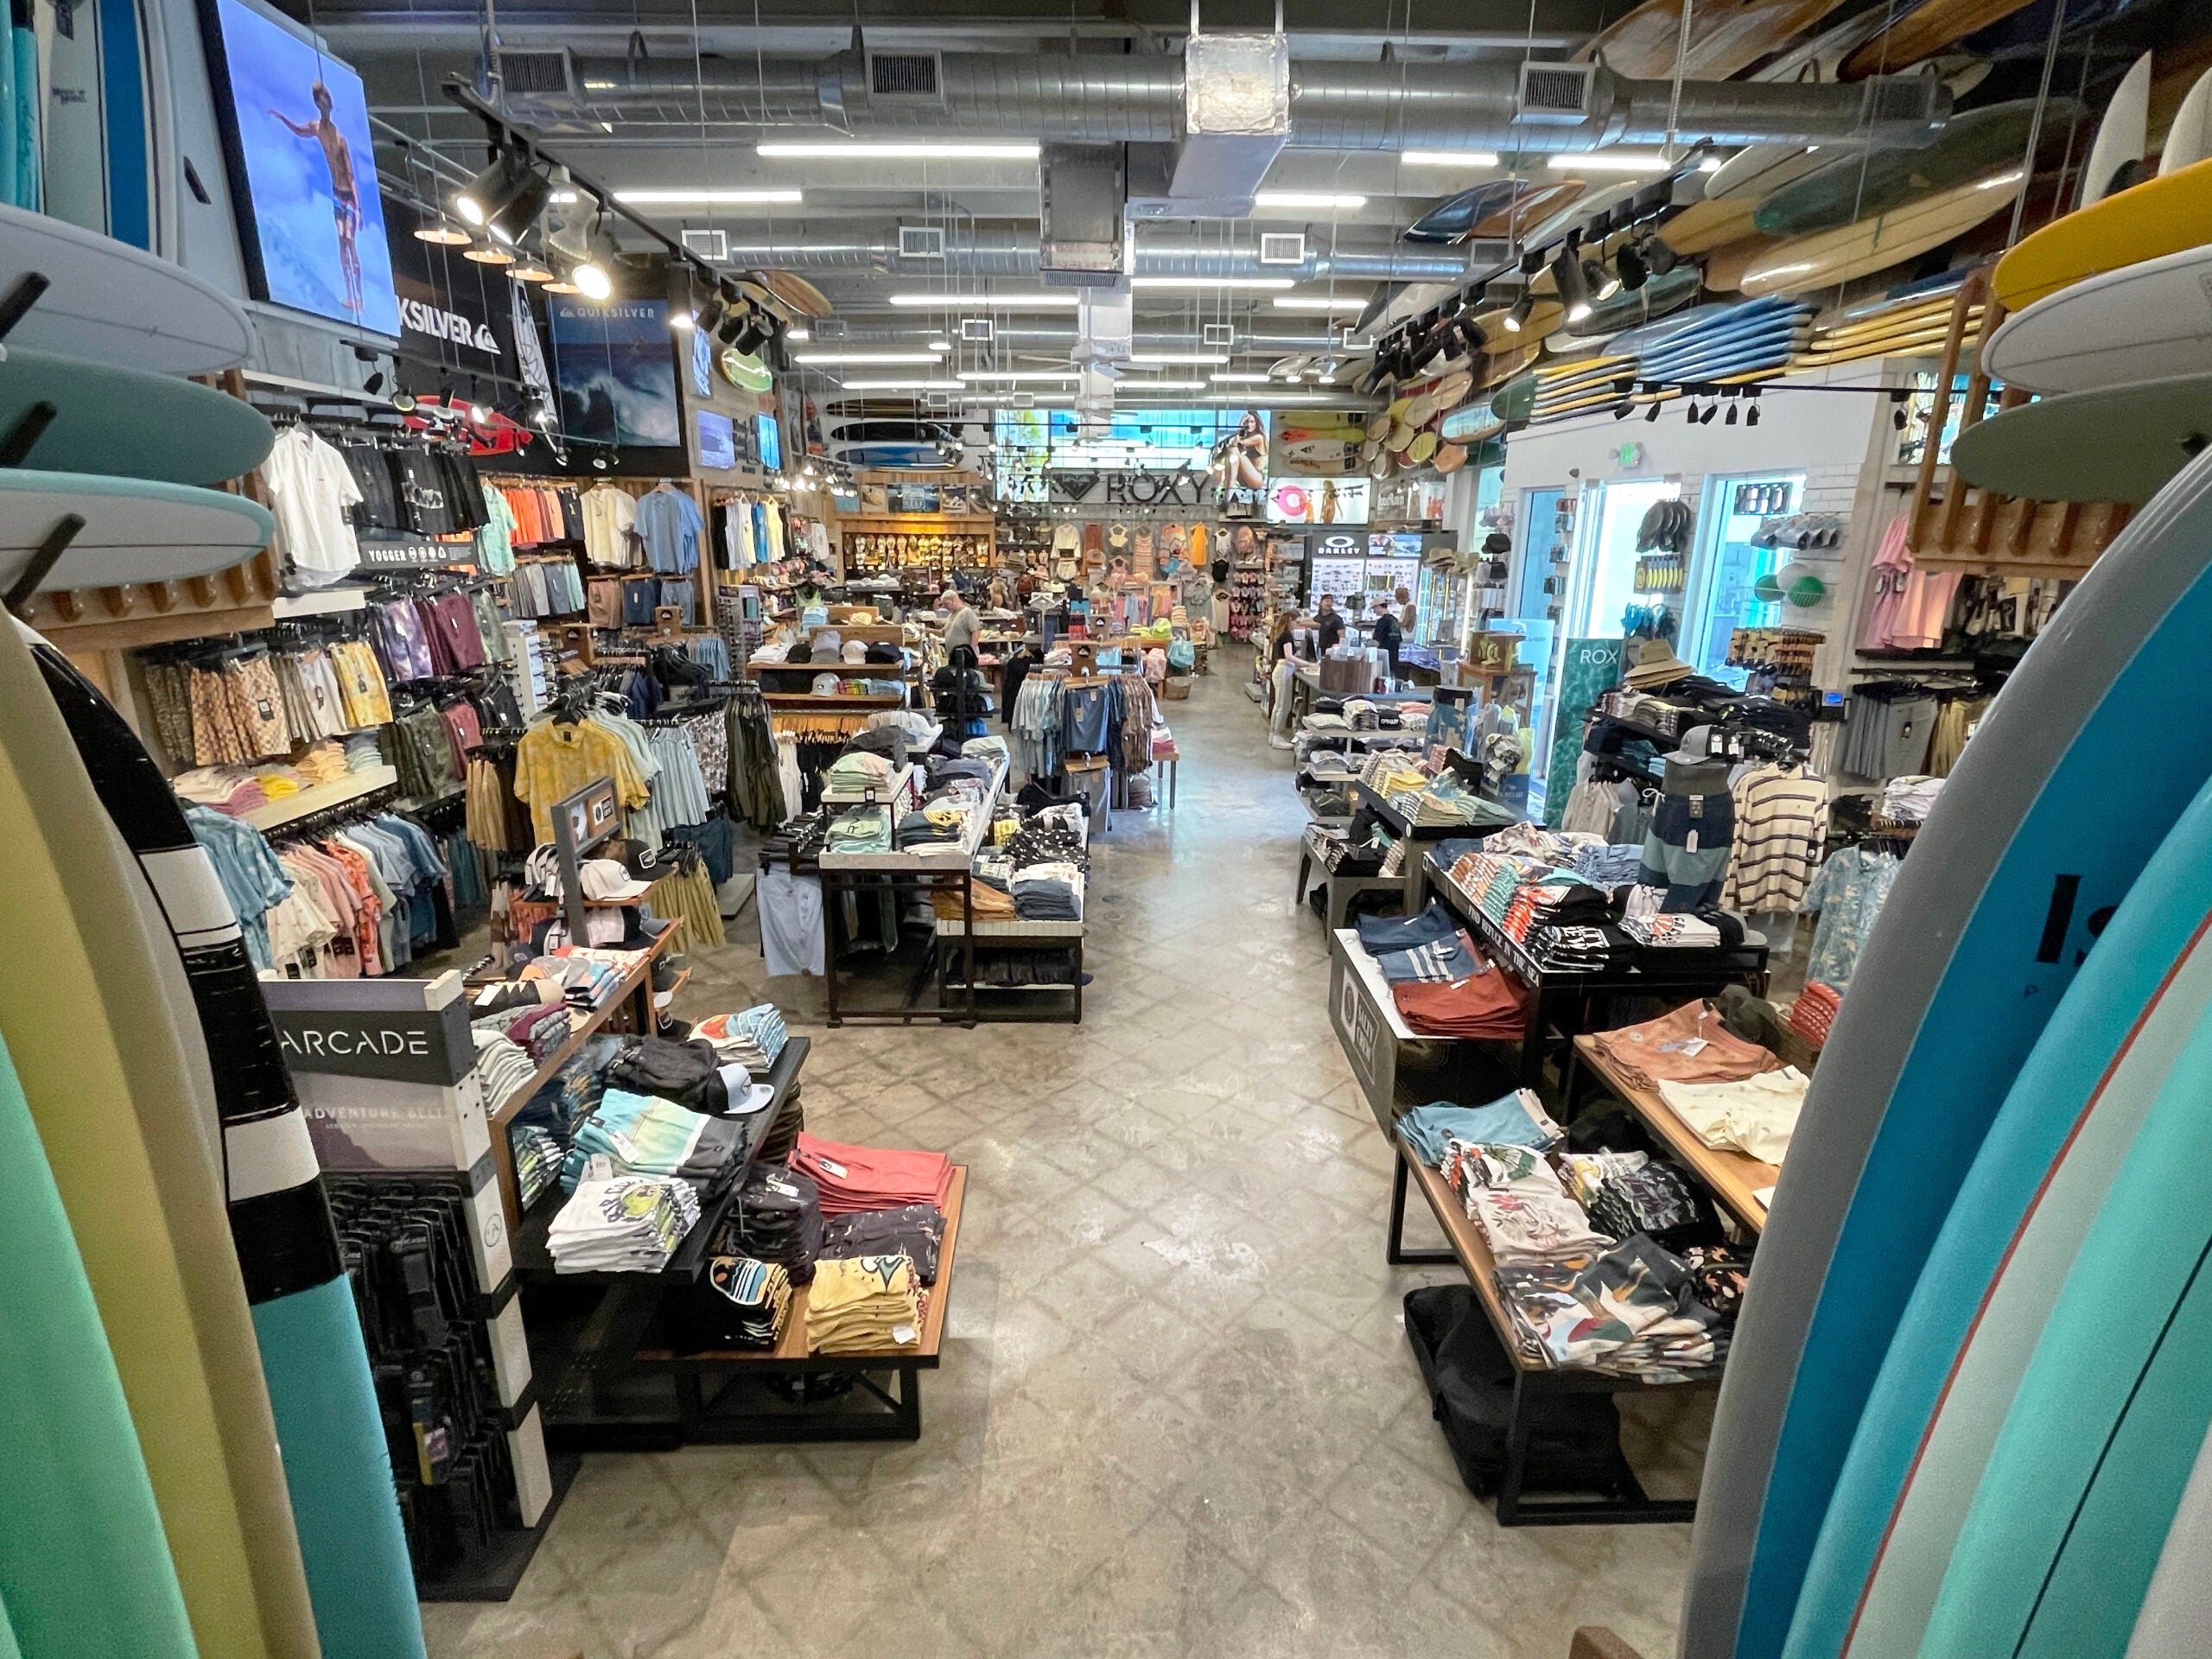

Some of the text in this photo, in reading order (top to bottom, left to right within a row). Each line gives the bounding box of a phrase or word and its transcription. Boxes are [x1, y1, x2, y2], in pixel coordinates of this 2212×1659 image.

[576, 308, 655, 319] QUIKSILVER
[1107, 473, 1208, 504] ROXY
[368, 550, 407, 562] YOGGER
[1580, 649, 1618, 664] ROX
[1513, 950, 1526, 972] THE
[1527, 965, 1539, 987] SEA
[281, 1029, 429, 1057] ARCADE
